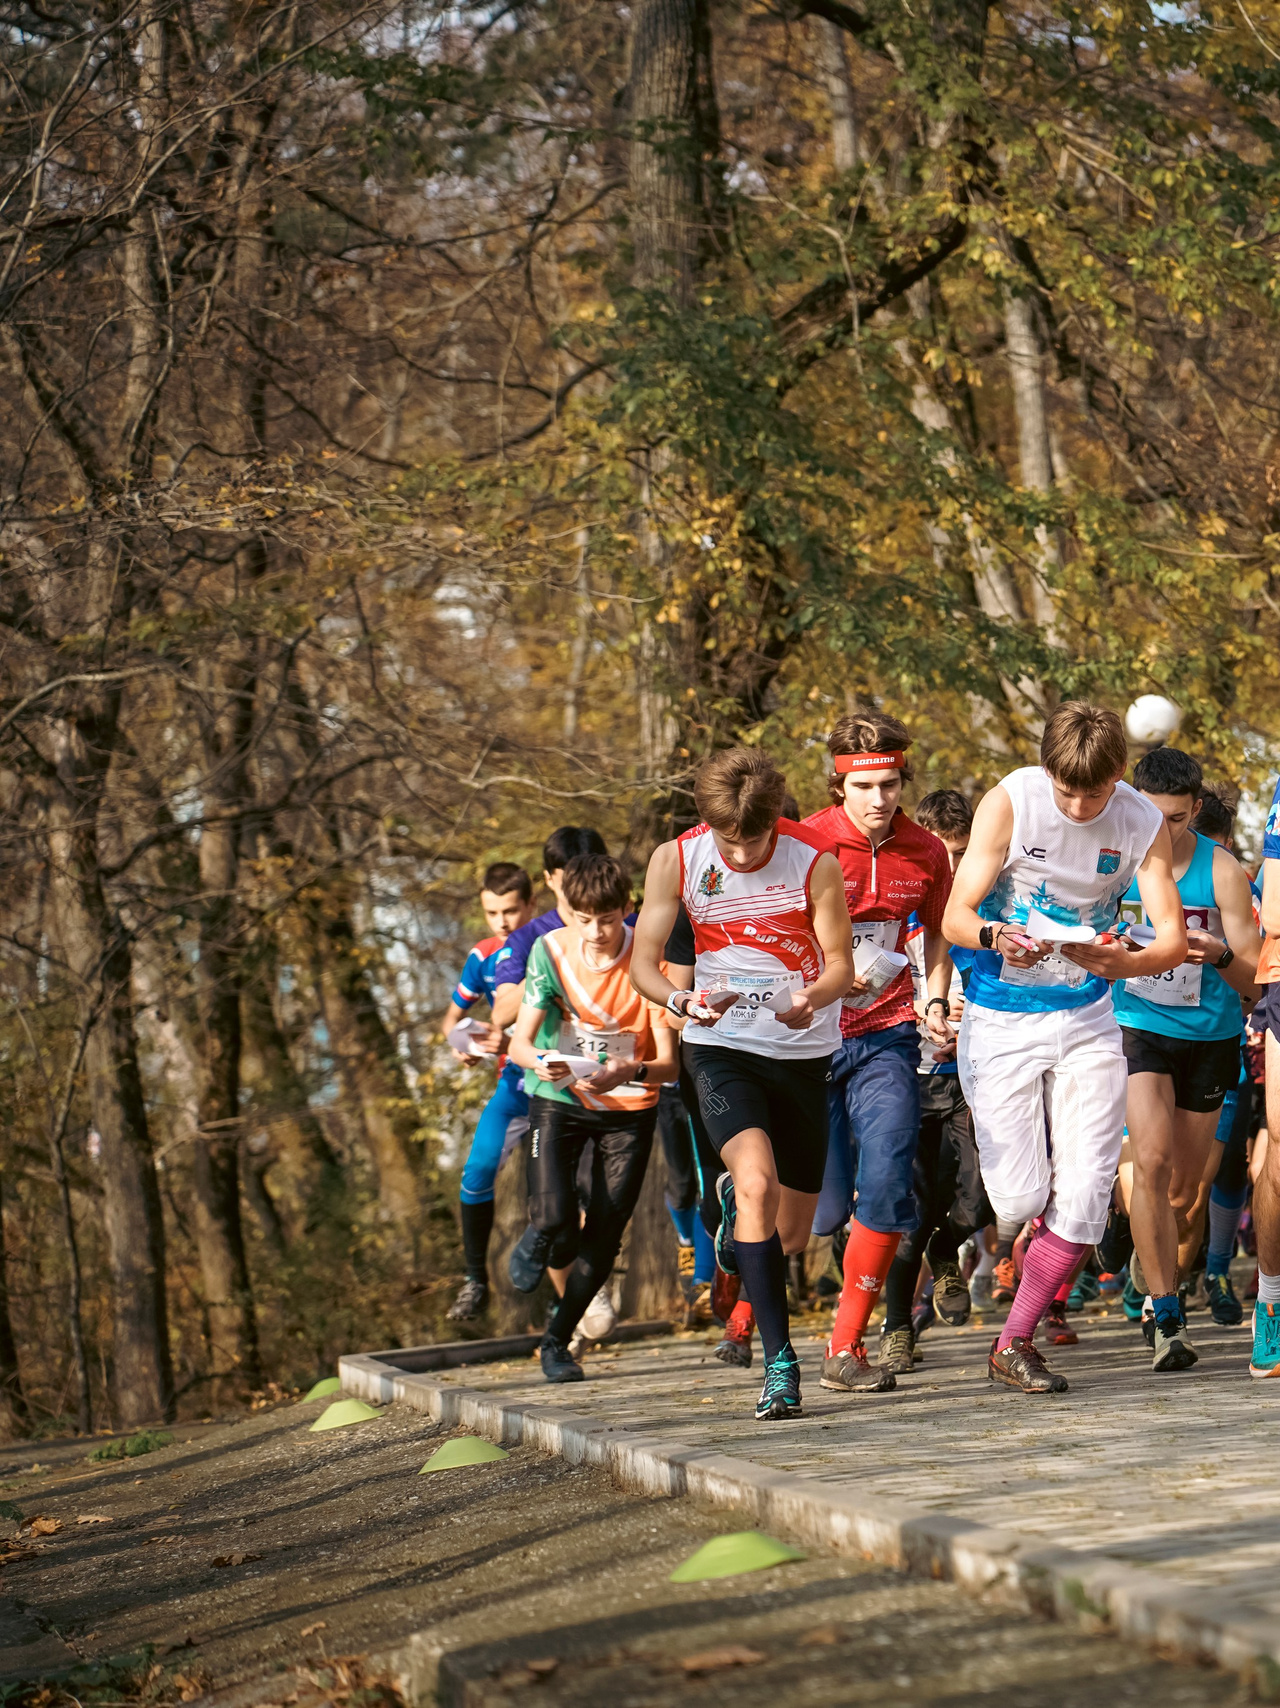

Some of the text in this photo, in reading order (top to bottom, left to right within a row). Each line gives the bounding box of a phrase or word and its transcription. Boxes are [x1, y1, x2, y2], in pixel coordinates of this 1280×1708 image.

[852, 756, 895, 766] noname
[1022, 845, 1046, 858] VC
[743, 925, 778, 943] Run
[780, 939, 808, 957] and
[881, 940, 885, 948] 1
[1137, 976, 1157, 987] МЖ16
[1182, 976, 1187, 984] 1
[731, 1010, 757, 1019] МЖ16
[576, 1037, 608, 1052] 212
